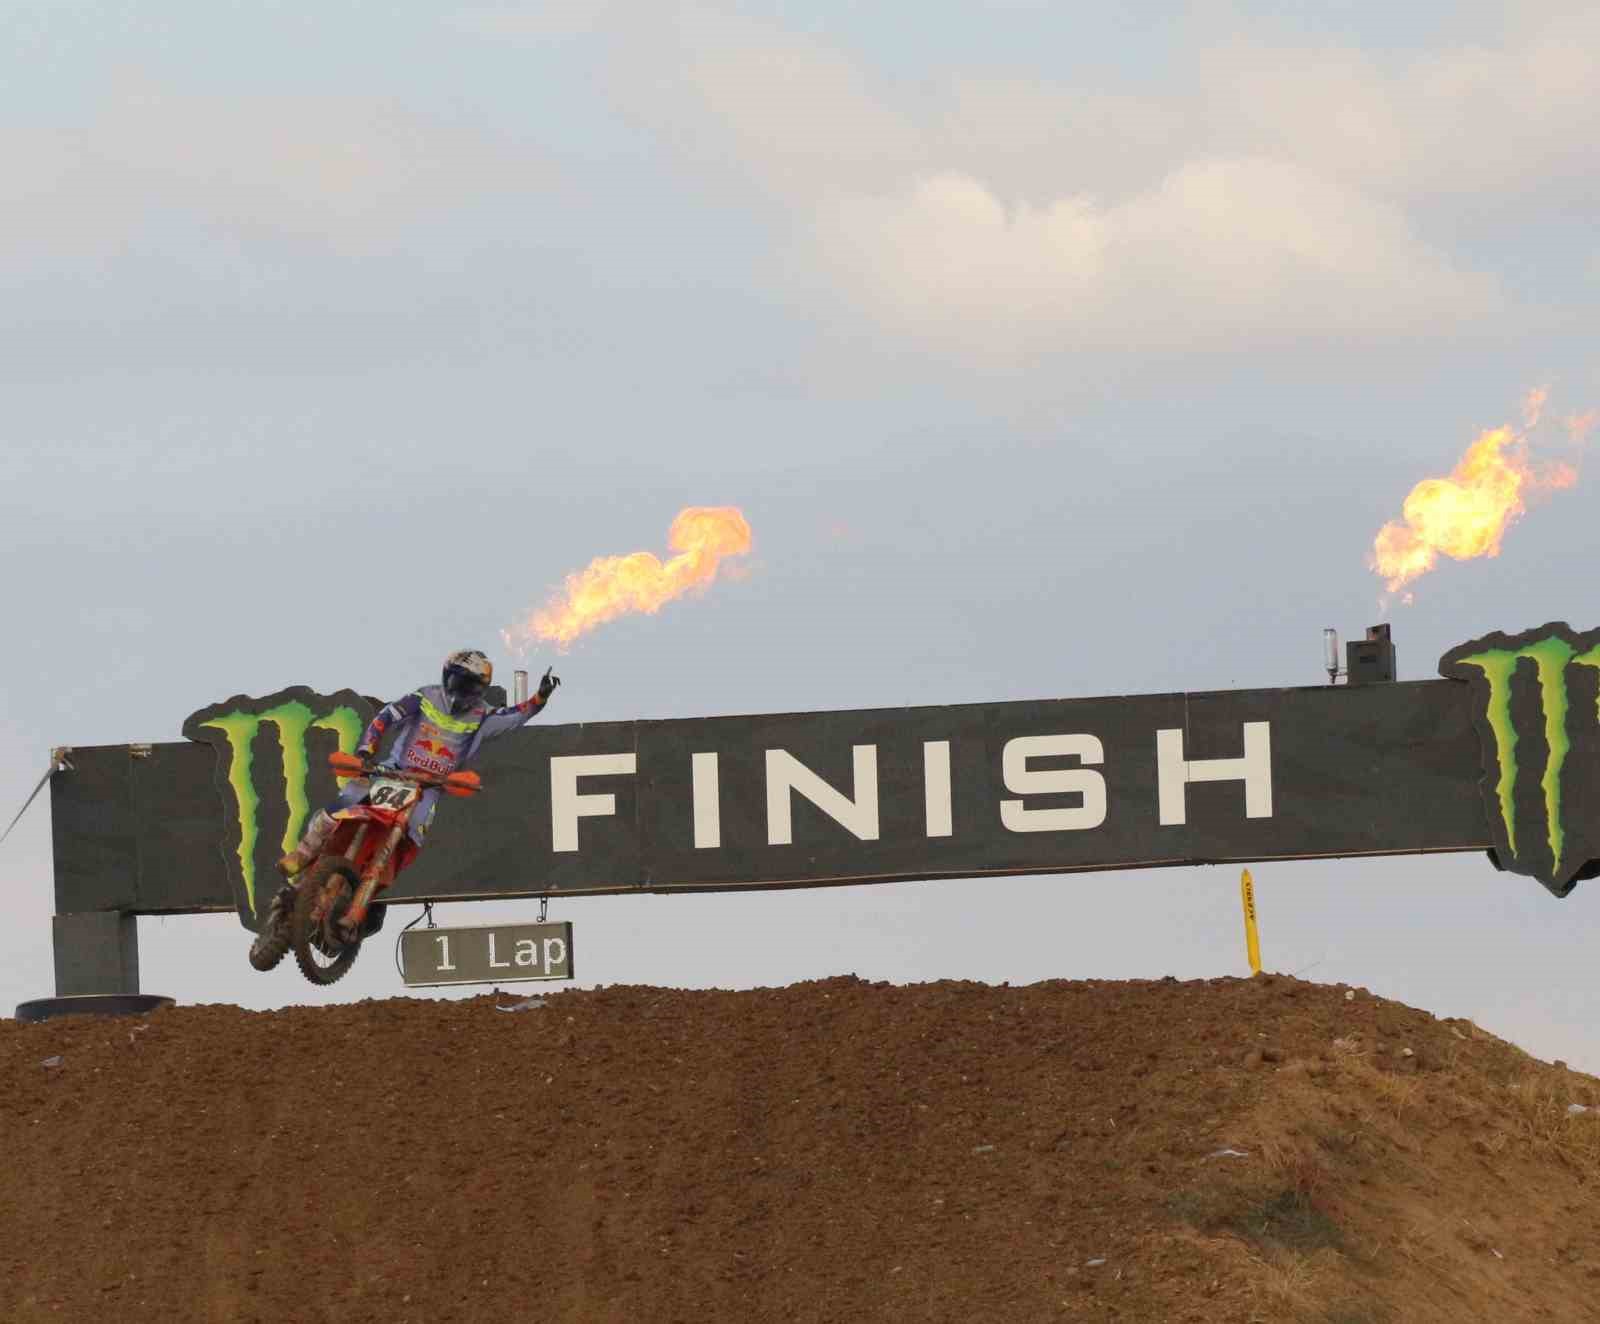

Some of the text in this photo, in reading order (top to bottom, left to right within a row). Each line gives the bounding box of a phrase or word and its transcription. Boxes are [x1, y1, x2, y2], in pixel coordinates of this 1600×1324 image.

[408, 750, 429, 767] Red
[372, 786, 410, 808] 84
[550, 721, 1273, 853] FINISH
[435, 932, 566, 974] 1 Lap
